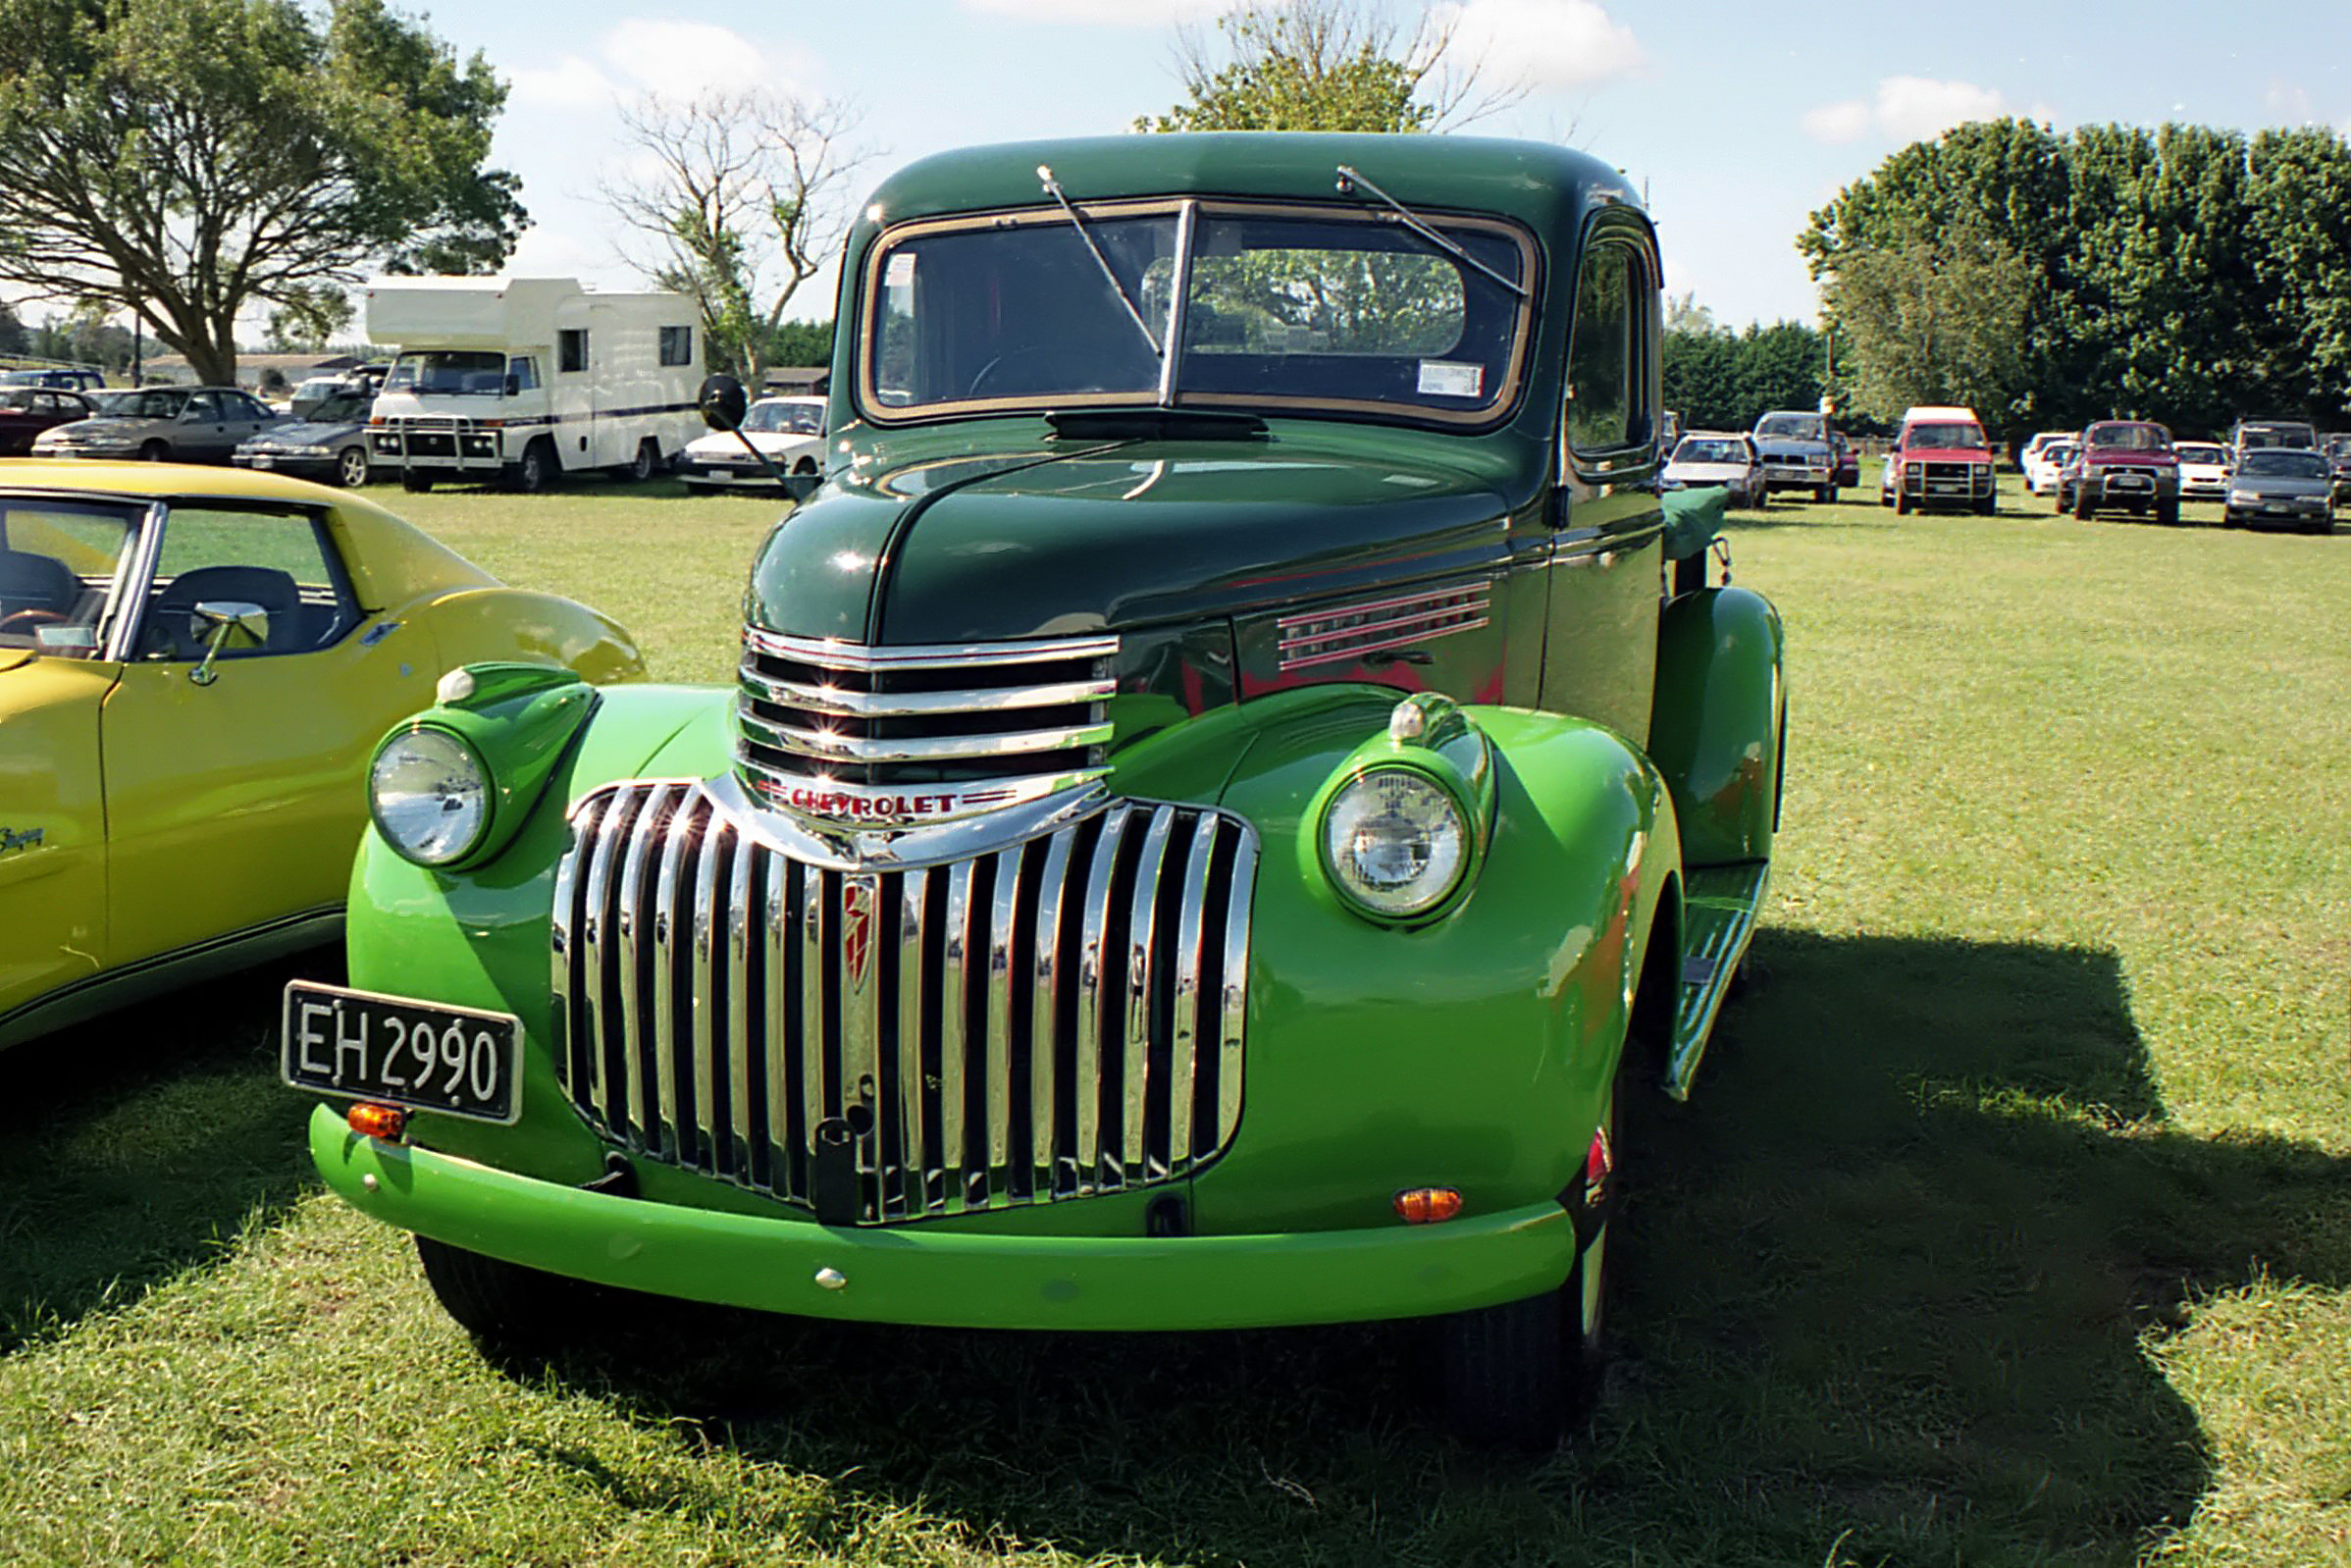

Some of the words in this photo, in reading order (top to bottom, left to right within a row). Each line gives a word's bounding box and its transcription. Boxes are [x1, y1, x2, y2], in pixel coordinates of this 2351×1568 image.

[791, 788, 958, 816] CHEVROLET
[299, 1002, 369, 1080] EH
[381, 1017, 498, 1101] 2990
